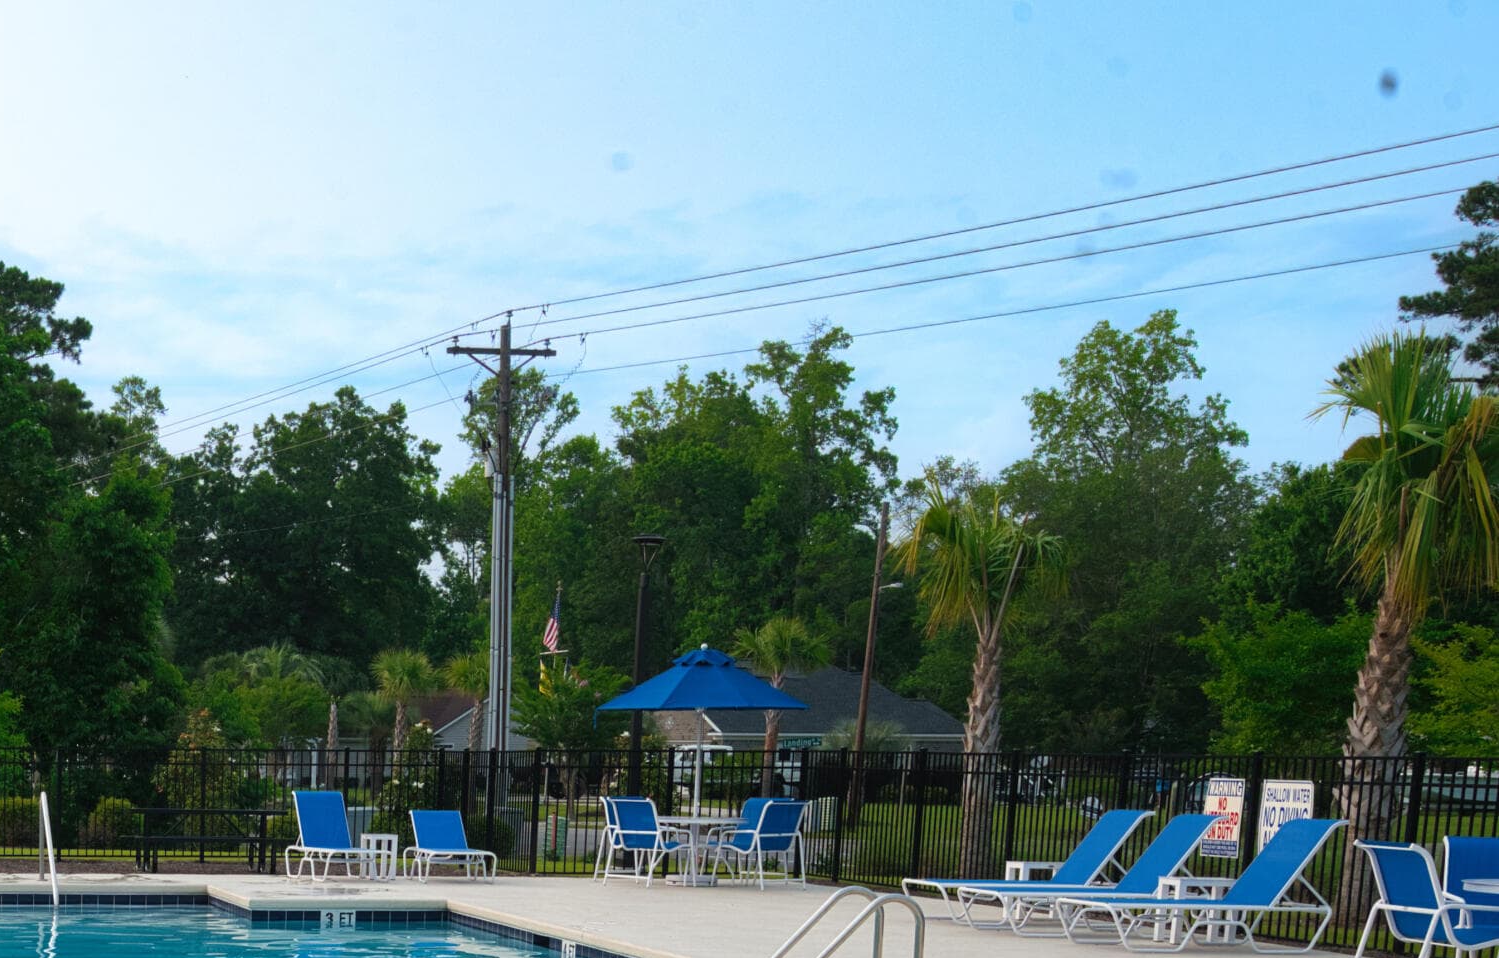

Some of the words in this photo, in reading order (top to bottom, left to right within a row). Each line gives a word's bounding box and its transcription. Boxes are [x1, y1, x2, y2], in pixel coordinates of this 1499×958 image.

[1209, 781, 1243, 796] WARNING
[1266, 788, 1290, 802] SHALLOW
[1293, 788, 1310, 803] WATER
[1218, 797, 1228, 810] NO
[1263, 806, 1276, 827] NO
[1217, 826, 1234, 839] DUTY
